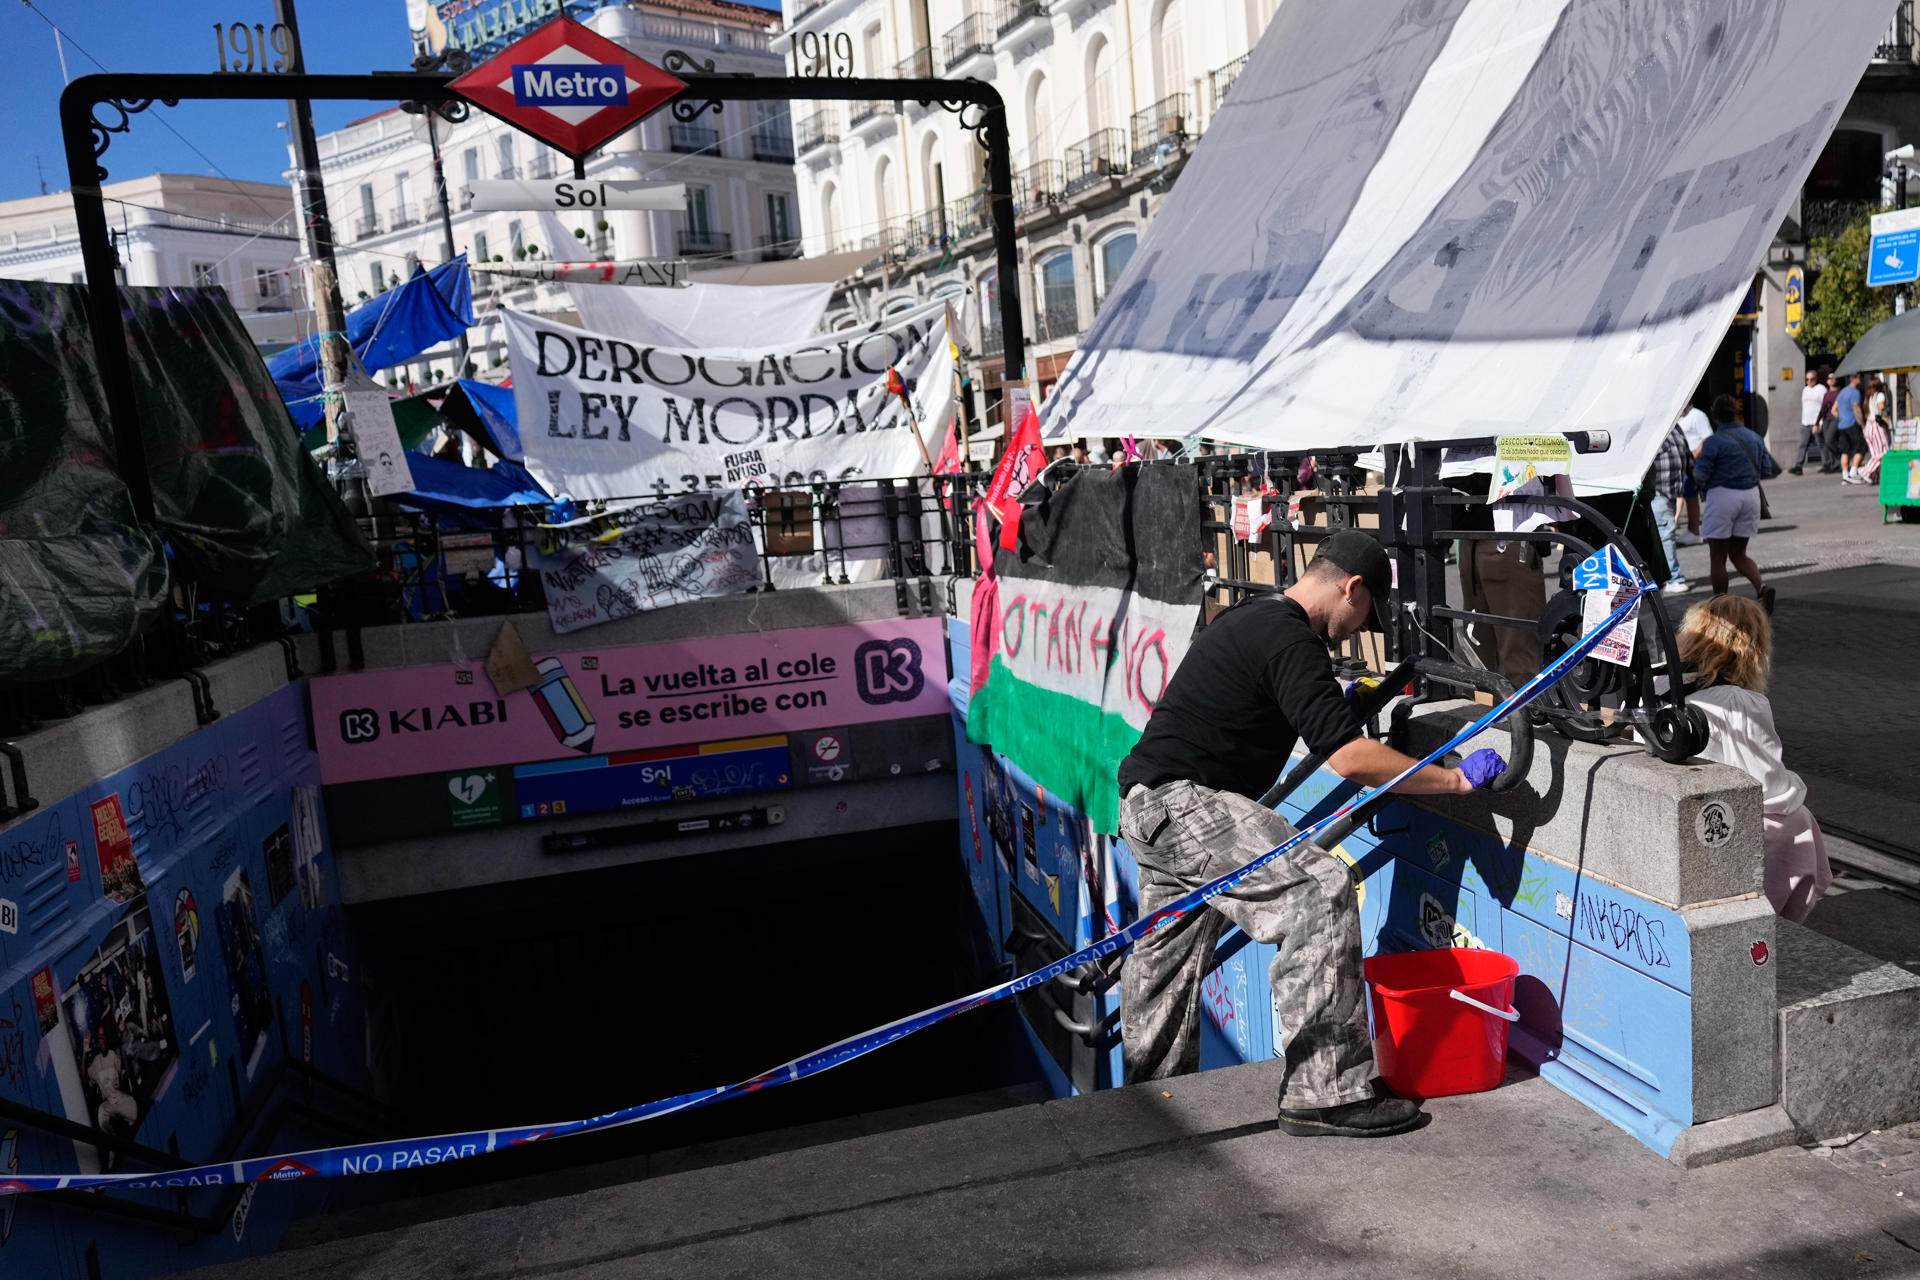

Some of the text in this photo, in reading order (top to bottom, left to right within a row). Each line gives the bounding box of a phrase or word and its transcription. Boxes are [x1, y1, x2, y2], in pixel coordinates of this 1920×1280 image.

[213, 22, 295, 72] 1919
[790, 31, 854, 78] 1919
[523, 70, 619, 98] Metro
[555, 183, 607, 207] Sol
[548, 390, 639, 442] LEY
[723, 449, 763, 469] FUERA
[727, 463, 767, 483] AYUSO
[1582, 556, 1601, 588] NO
[1002, 594, 1169, 715] OTAN NO
[601, 653, 837, 697] La vuelta al cole
[389, 700, 508, 734] KIABI
[618, 689, 827, 729] se escribe con
[641, 765, 672, 784] Sol
[1048, 941, 1118, 978] PASAR
[272, 1168, 302, 1180] Metro
[342, 1143, 476, 1176] NO PASAR
